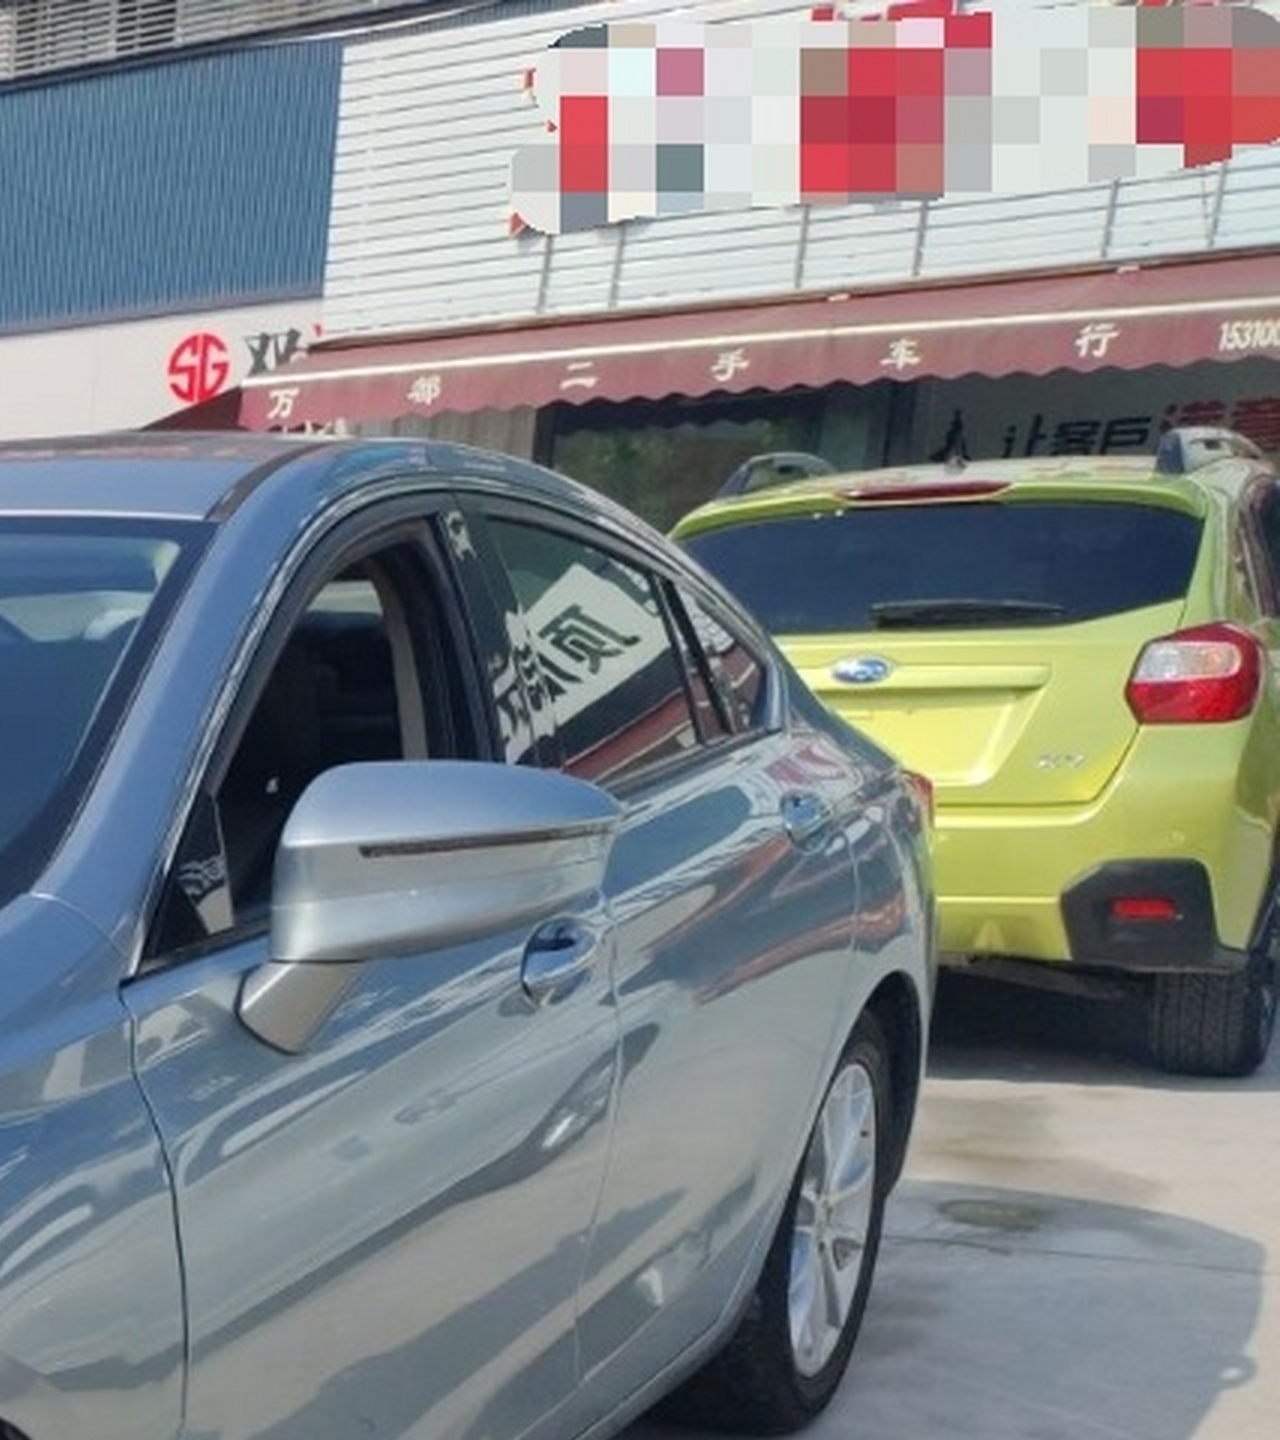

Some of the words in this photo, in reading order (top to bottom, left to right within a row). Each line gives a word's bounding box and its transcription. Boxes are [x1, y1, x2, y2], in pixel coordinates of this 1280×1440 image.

[167, 331, 231, 403] SG
[267, 322, 1121, 419] 万都二手车行
